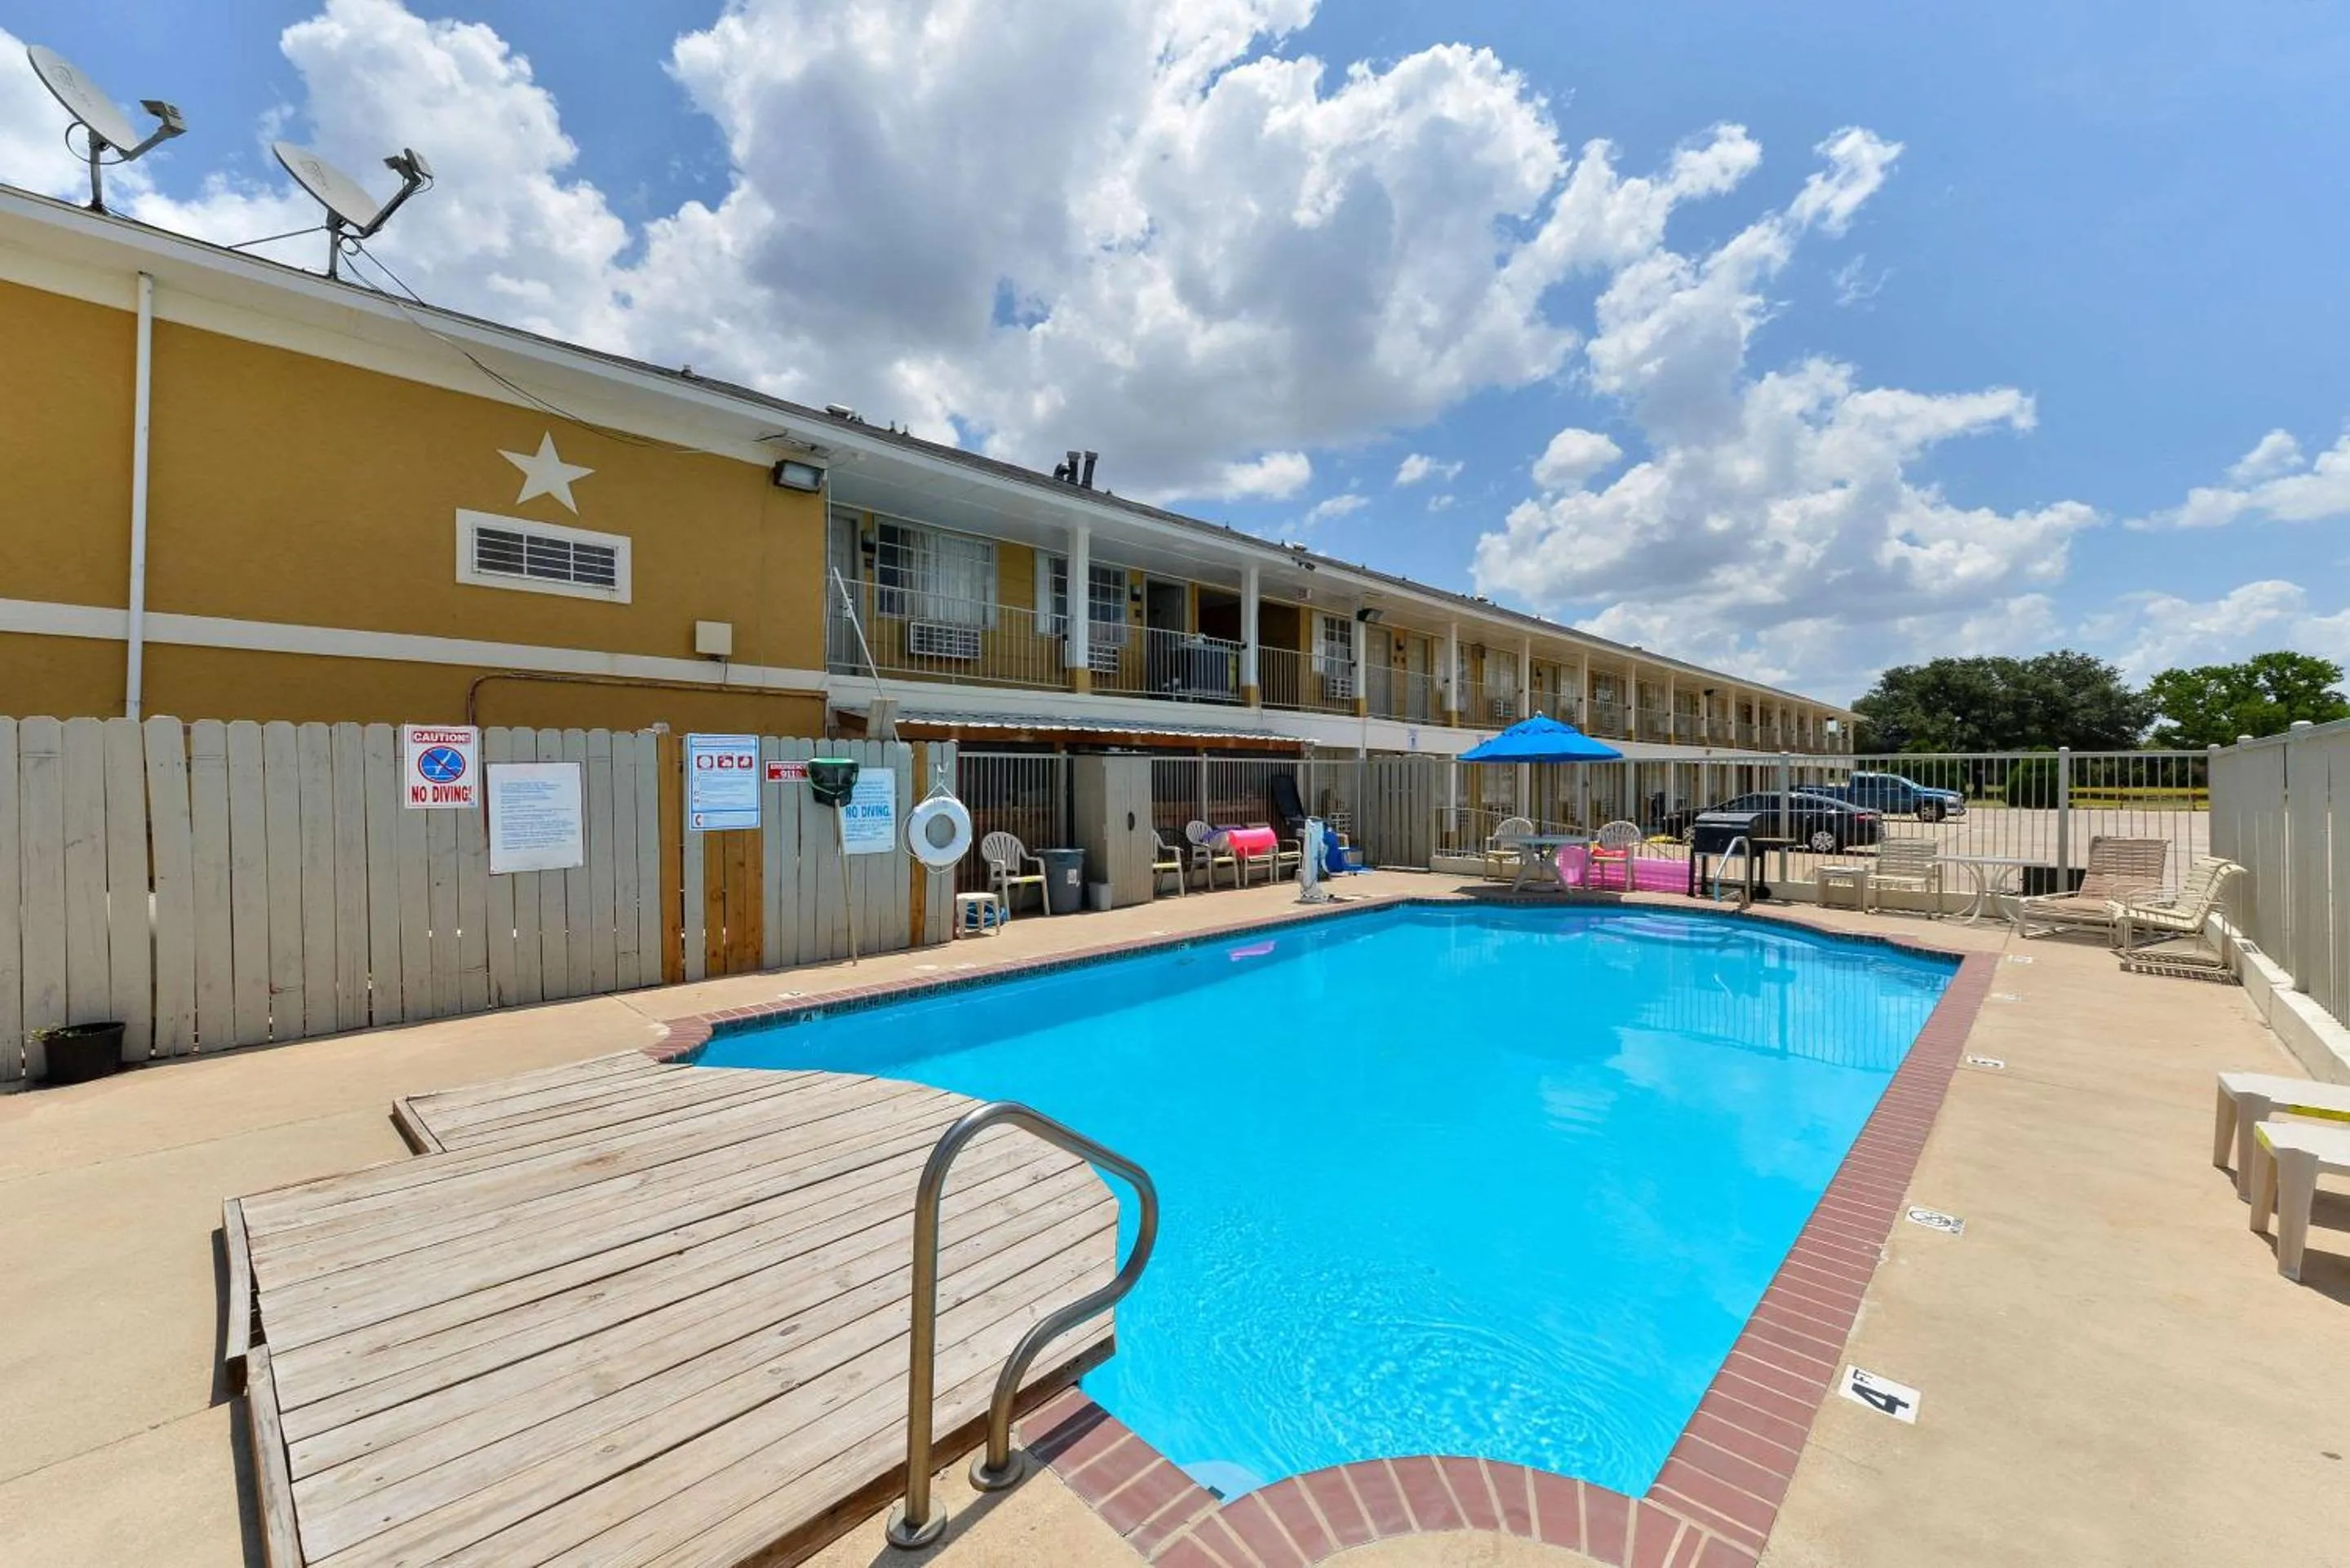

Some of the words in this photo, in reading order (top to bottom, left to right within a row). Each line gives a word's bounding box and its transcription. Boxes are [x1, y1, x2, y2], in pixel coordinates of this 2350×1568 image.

[411, 786, 427, 803] NO
[845, 806, 858, 818] NO
[1851, 1382, 1910, 1415] 4
